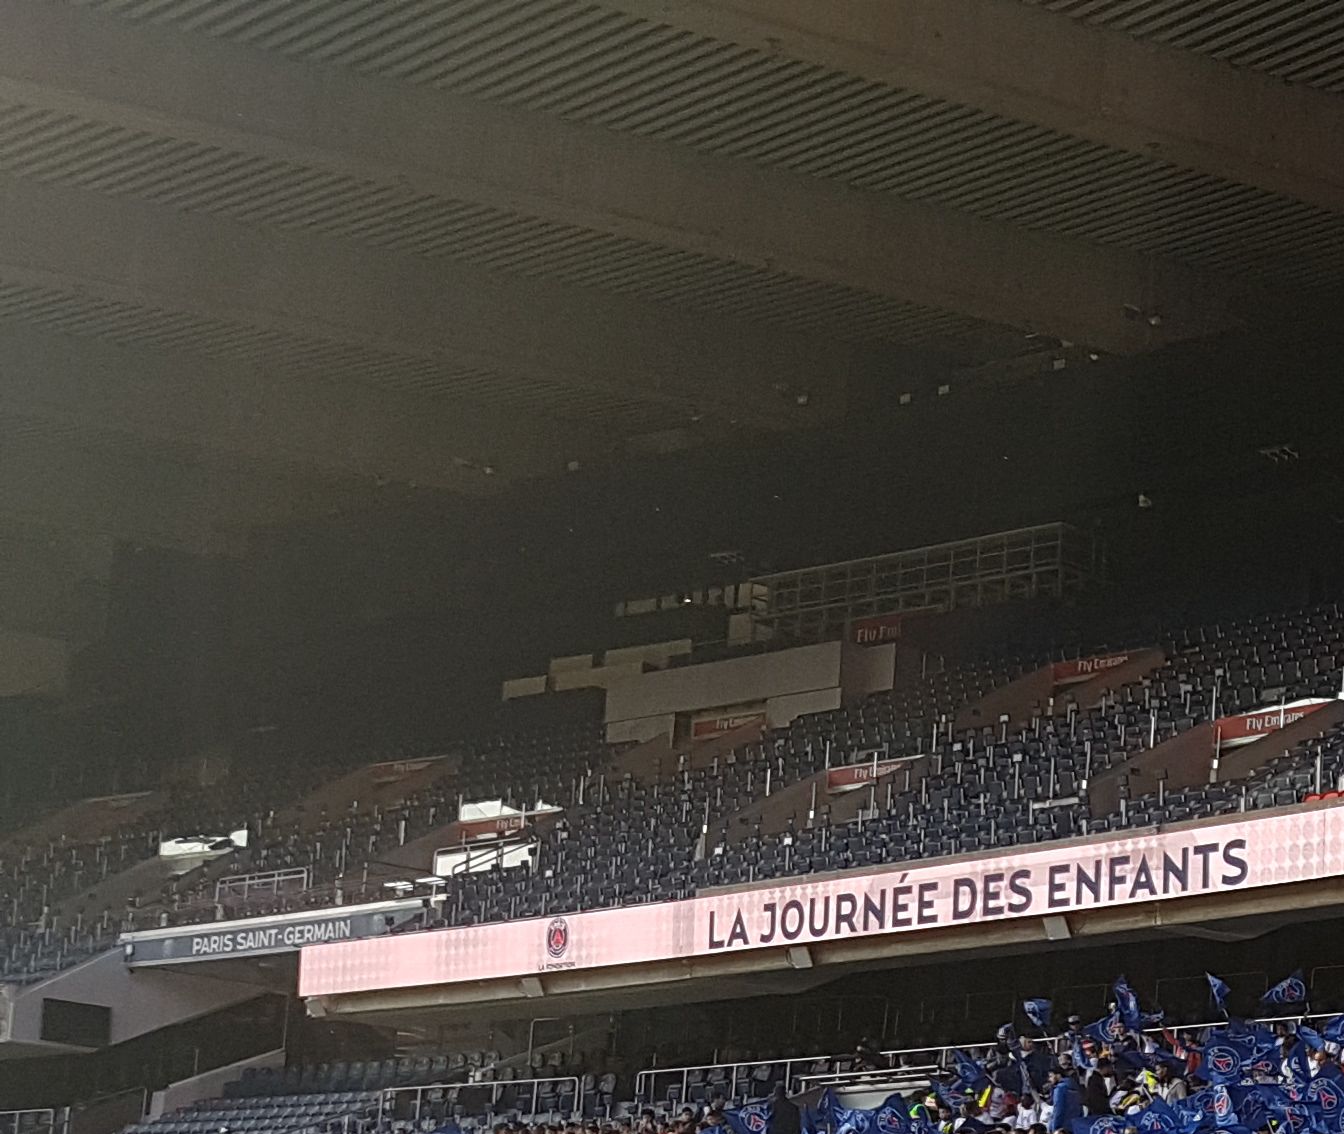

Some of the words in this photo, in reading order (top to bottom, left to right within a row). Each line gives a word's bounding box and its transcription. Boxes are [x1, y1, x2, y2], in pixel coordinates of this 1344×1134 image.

[1078, 659, 1093, 672] Fly
[1246, 717, 1263, 730] Fly
[708, 907, 750, 950] LA
[760, 873, 939, 943] JOURNÉE
[952, 869, 1033, 921] DES
[1048, 839, 1249, 908] ENFANTS
[192, 934, 234, 955] PARIS
[236, 919, 351, 950] SAINT-GERMAIN
